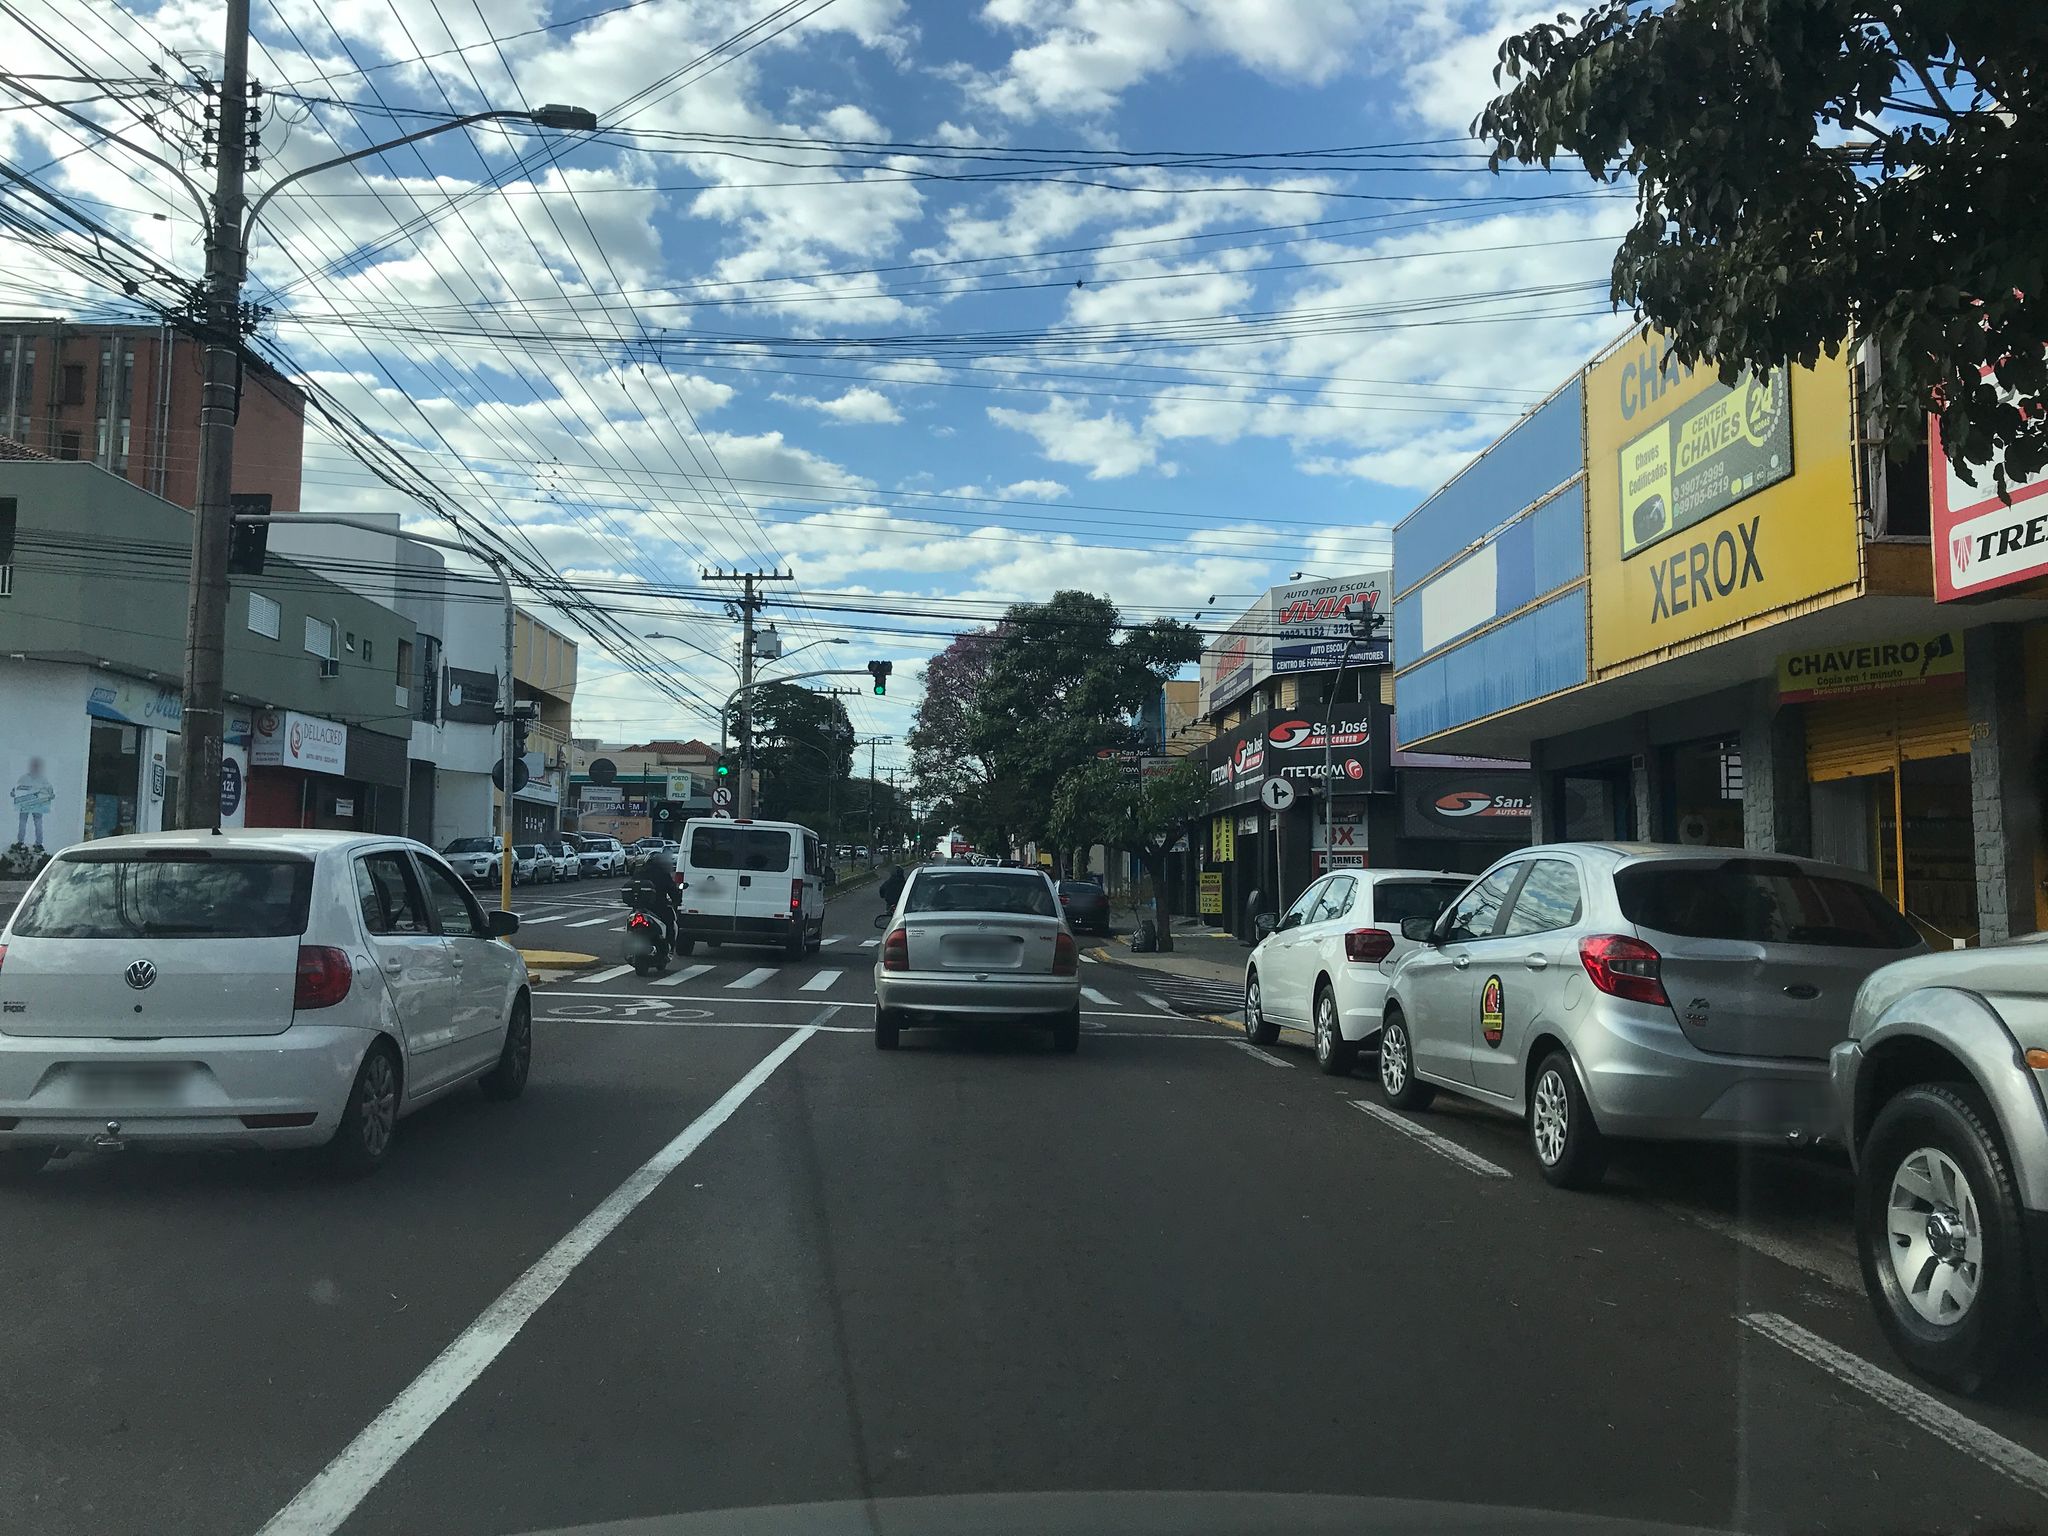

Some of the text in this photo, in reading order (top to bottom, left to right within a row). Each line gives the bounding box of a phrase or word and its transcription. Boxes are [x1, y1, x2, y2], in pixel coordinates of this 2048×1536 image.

[1750, 378, 1776, 424] 24
[1692, 401, 1727, 435] CENTER
[1681, 411, 1740, 467] CHAVES
[1636, 444, 1659, 471] Chaves
[1629, 462, 1667, 496] Codificadas
[1679, 461, 1725, 497] 3907-2999
[1678, 475, 1729, 515] 99705-6219
[1649, 515, 1764, 624] XEROX
[1284, 580, 1375, 599] AUTO MOTO ESCOLA
[1279, 590, 1381, 625] VIVIAN
[1310, 642, 1348, 655] AUTO ESCOLA
[1787, 641, 1919, 676] CHAVEIRO
[1276, 660, 1298, 670] CENTRO
[1298, 660, 1306, 668] DE
[1845, 675, 1859, 683] em
[1862, 672, 1867, 681] 1
[1870, 669, 1903, 680] minuto
[1338, 717, 1368, 734] José
[1311, 735, 1358, 745] AUT CENTER
[222, 780, 235, 792] 12X
[1493, 795, 1524, 807] San
[1320, 856, 1362, 864] AARMES
